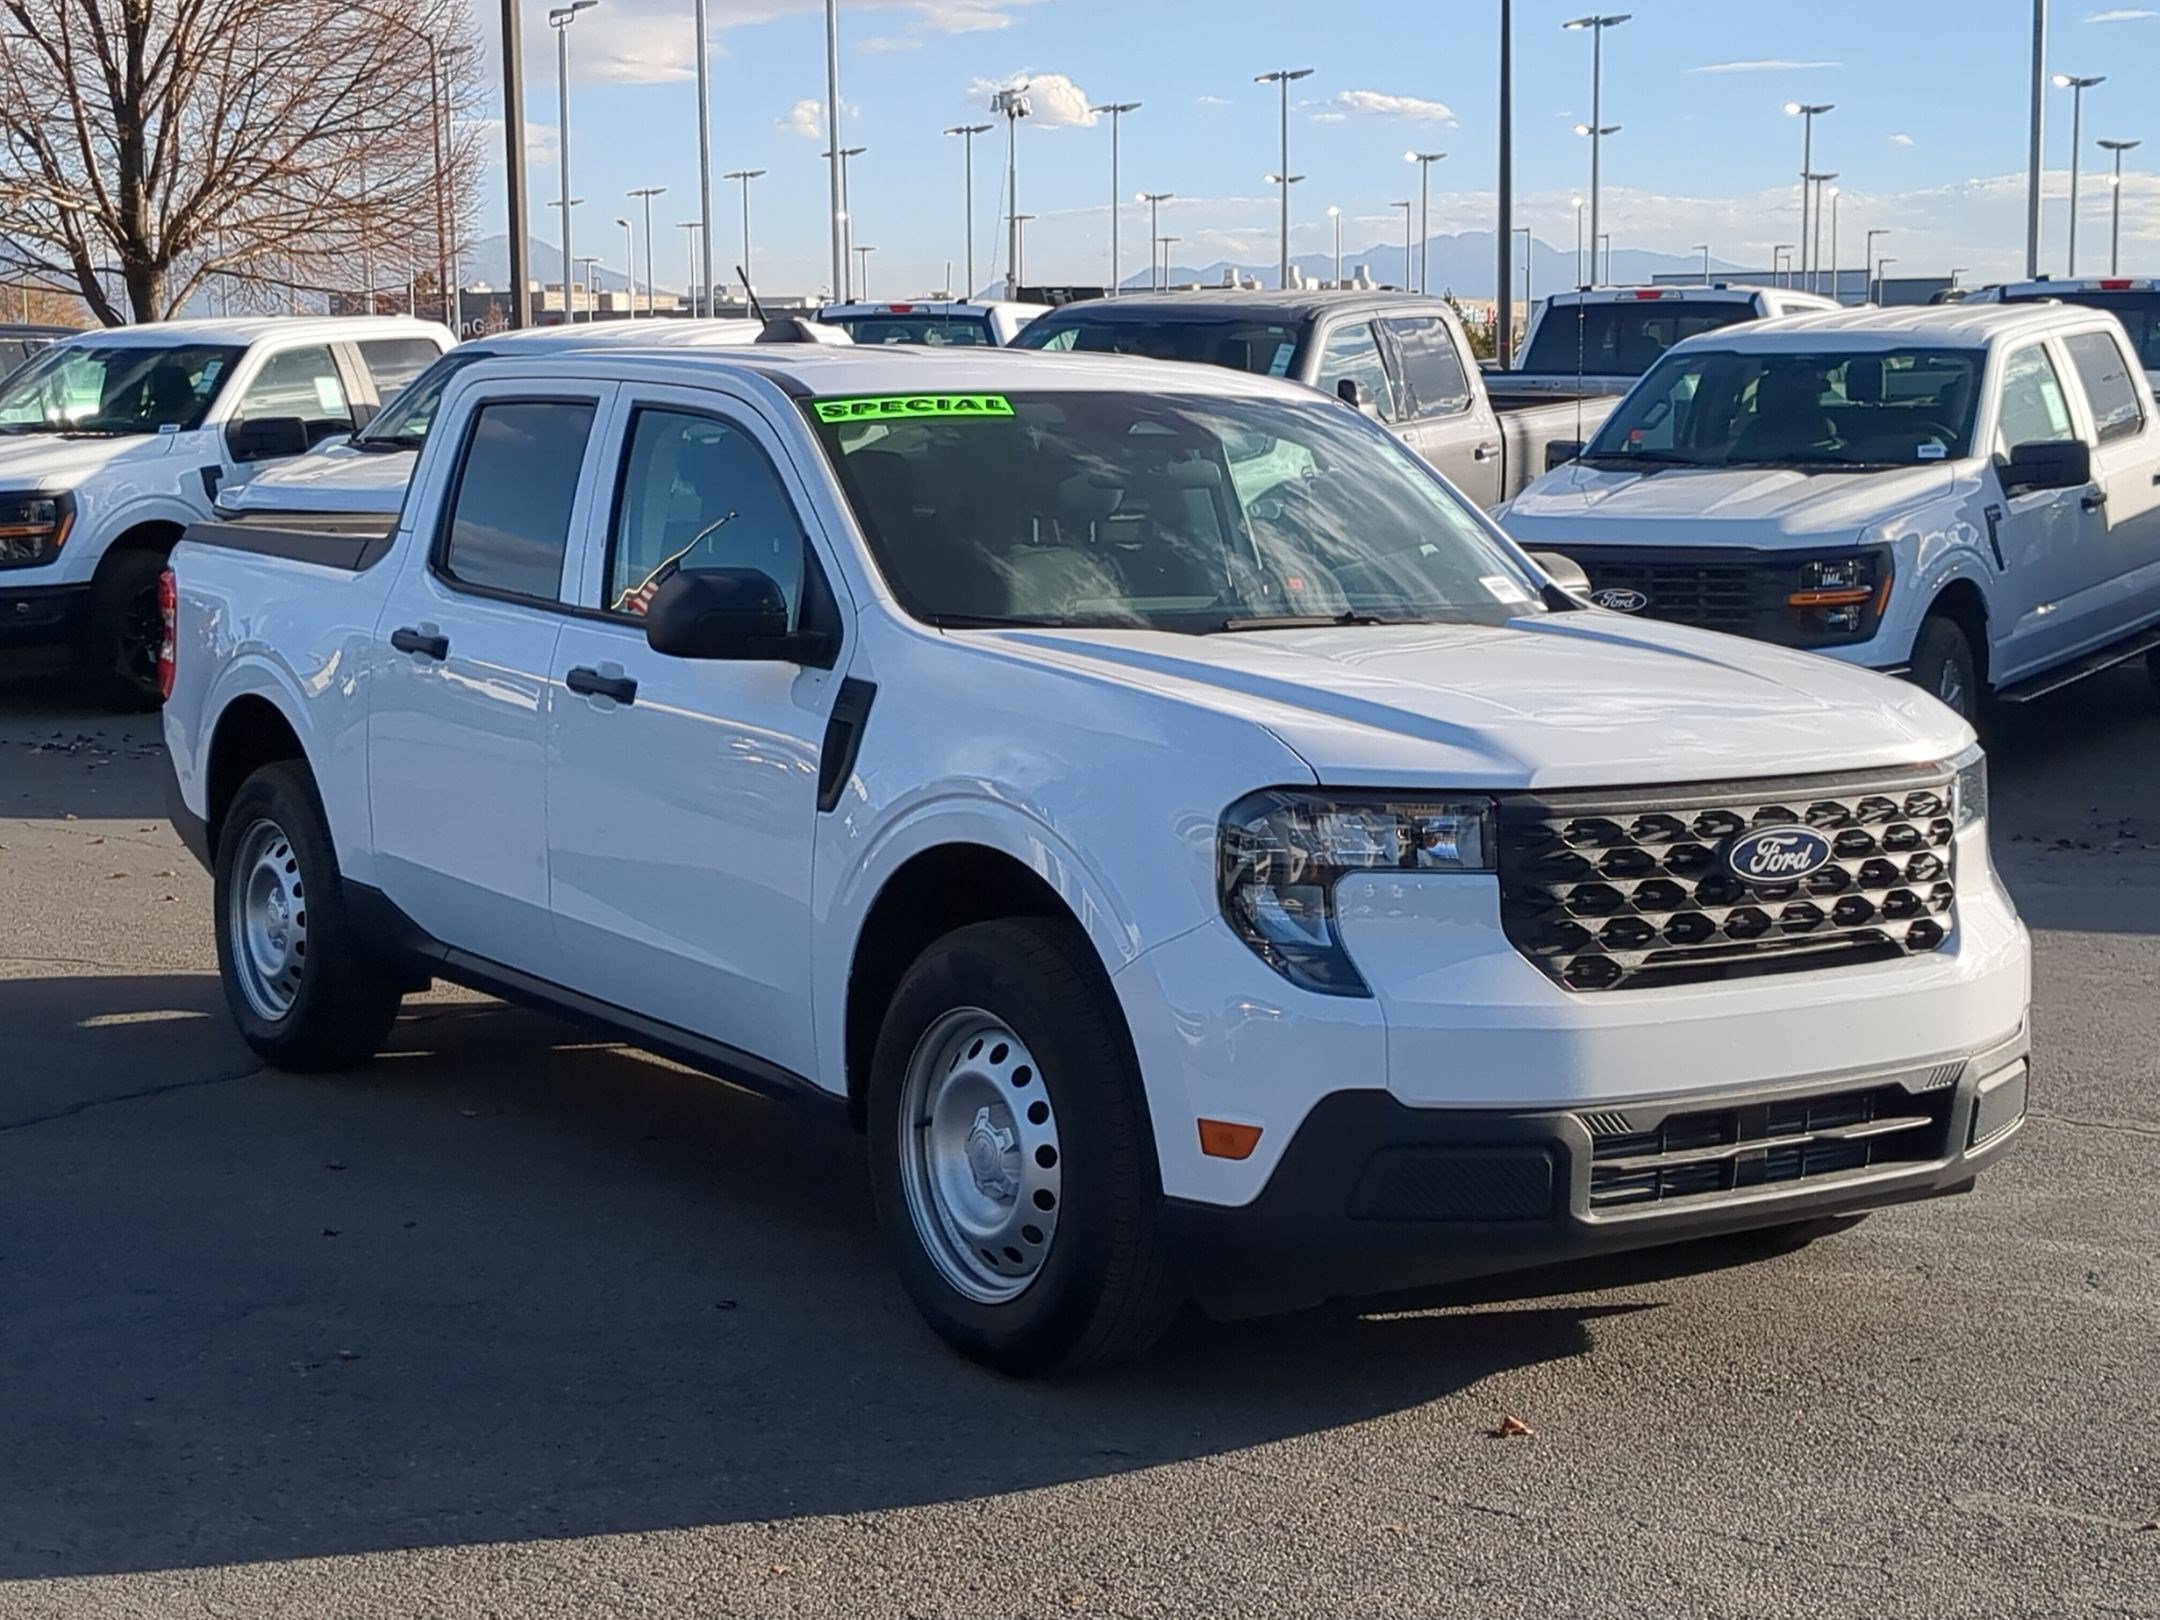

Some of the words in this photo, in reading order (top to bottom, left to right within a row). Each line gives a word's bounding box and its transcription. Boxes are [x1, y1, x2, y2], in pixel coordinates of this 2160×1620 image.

[821, 398, 1007, 418] SPECIAL
[1600, 591, 1636, 609] Ford
[1749, 836, 1814, 874] Ford
